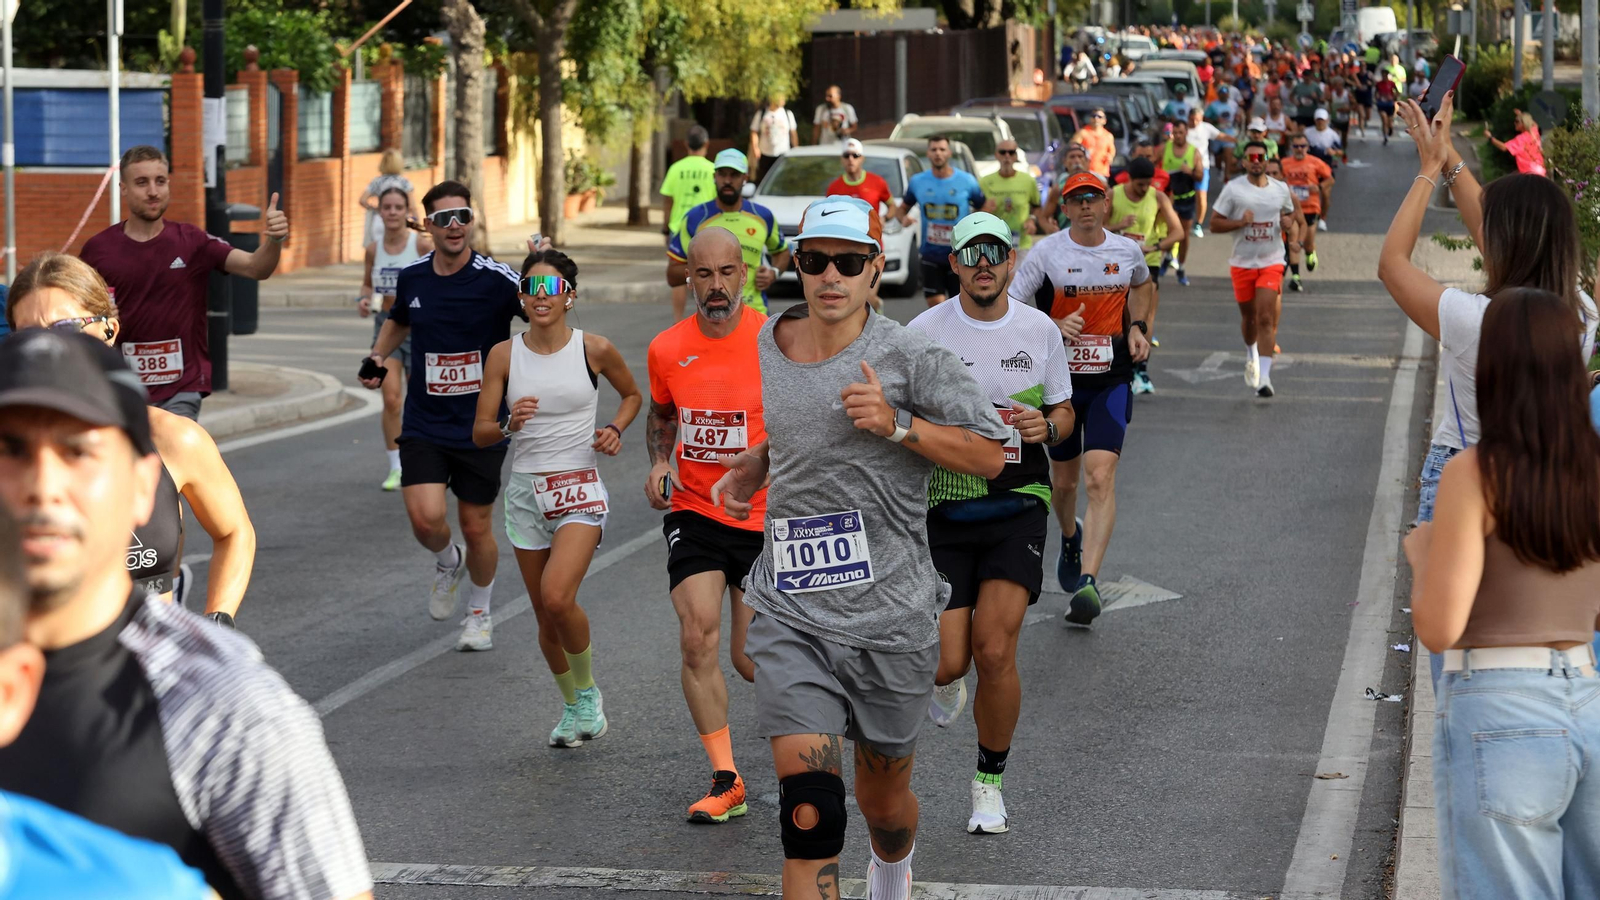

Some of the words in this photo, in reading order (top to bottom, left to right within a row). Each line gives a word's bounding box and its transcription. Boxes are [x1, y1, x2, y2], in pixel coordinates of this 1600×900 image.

[1078, 284, 1124, 292] RUBYSAN
[1073, 348, 1100, 361] 284
[138, 356, 167, 371] 388
[1001, 359, 1031, 369] PHYSICAL
[439, 367, 467, 382] 401
[693, 428, 729, 446] 487
[552, 486, 588, 508] 246
[793, 527, 815, 538] XXIX
[786, 537, 851, 568] 1010
